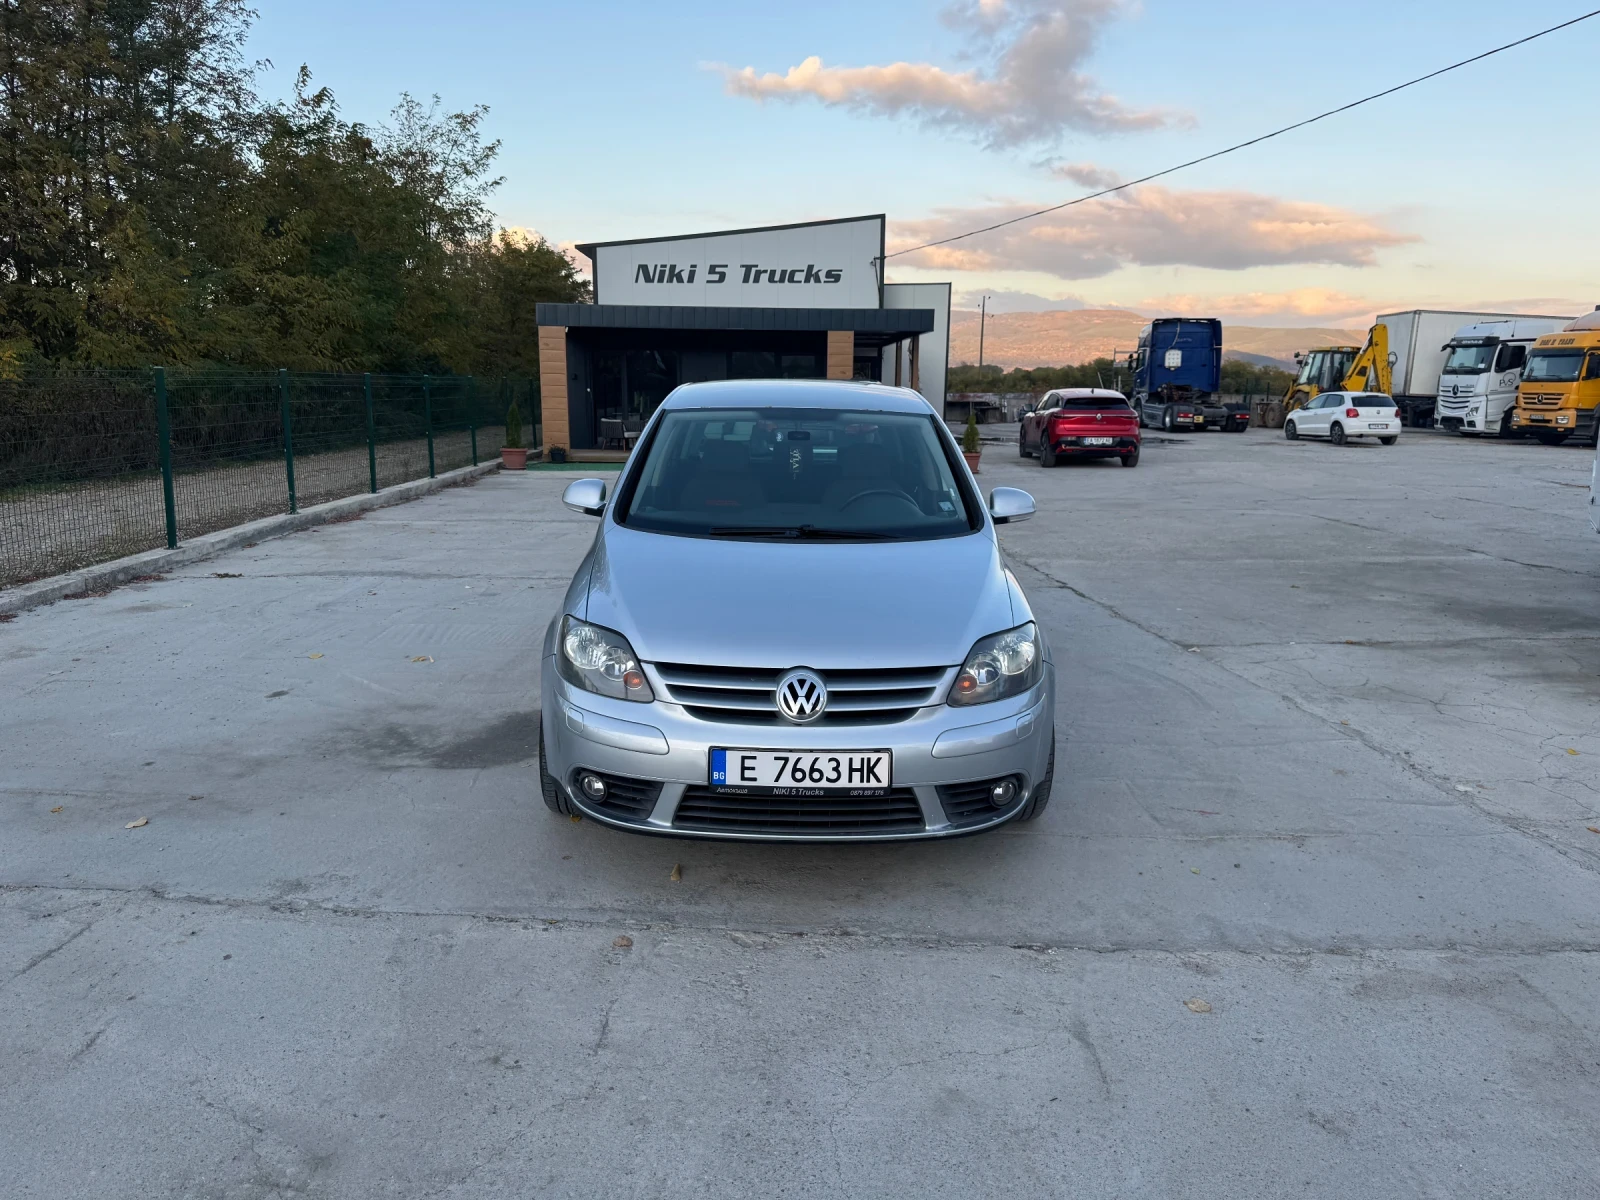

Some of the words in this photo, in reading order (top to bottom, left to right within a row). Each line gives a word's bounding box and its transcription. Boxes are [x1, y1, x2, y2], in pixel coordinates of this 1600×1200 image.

[634, 264, 697, 284] Niki
[706, 264, 728, 284] 5
[740, 264, 843, 284] Trucks
[713, 771, 725, 780] BG
[740, 755, 757, 782] E
[773, 756, 842, 783] 7663
[847, 756, 883, 783] HK
[798, 788, 824, 796] Trucks
